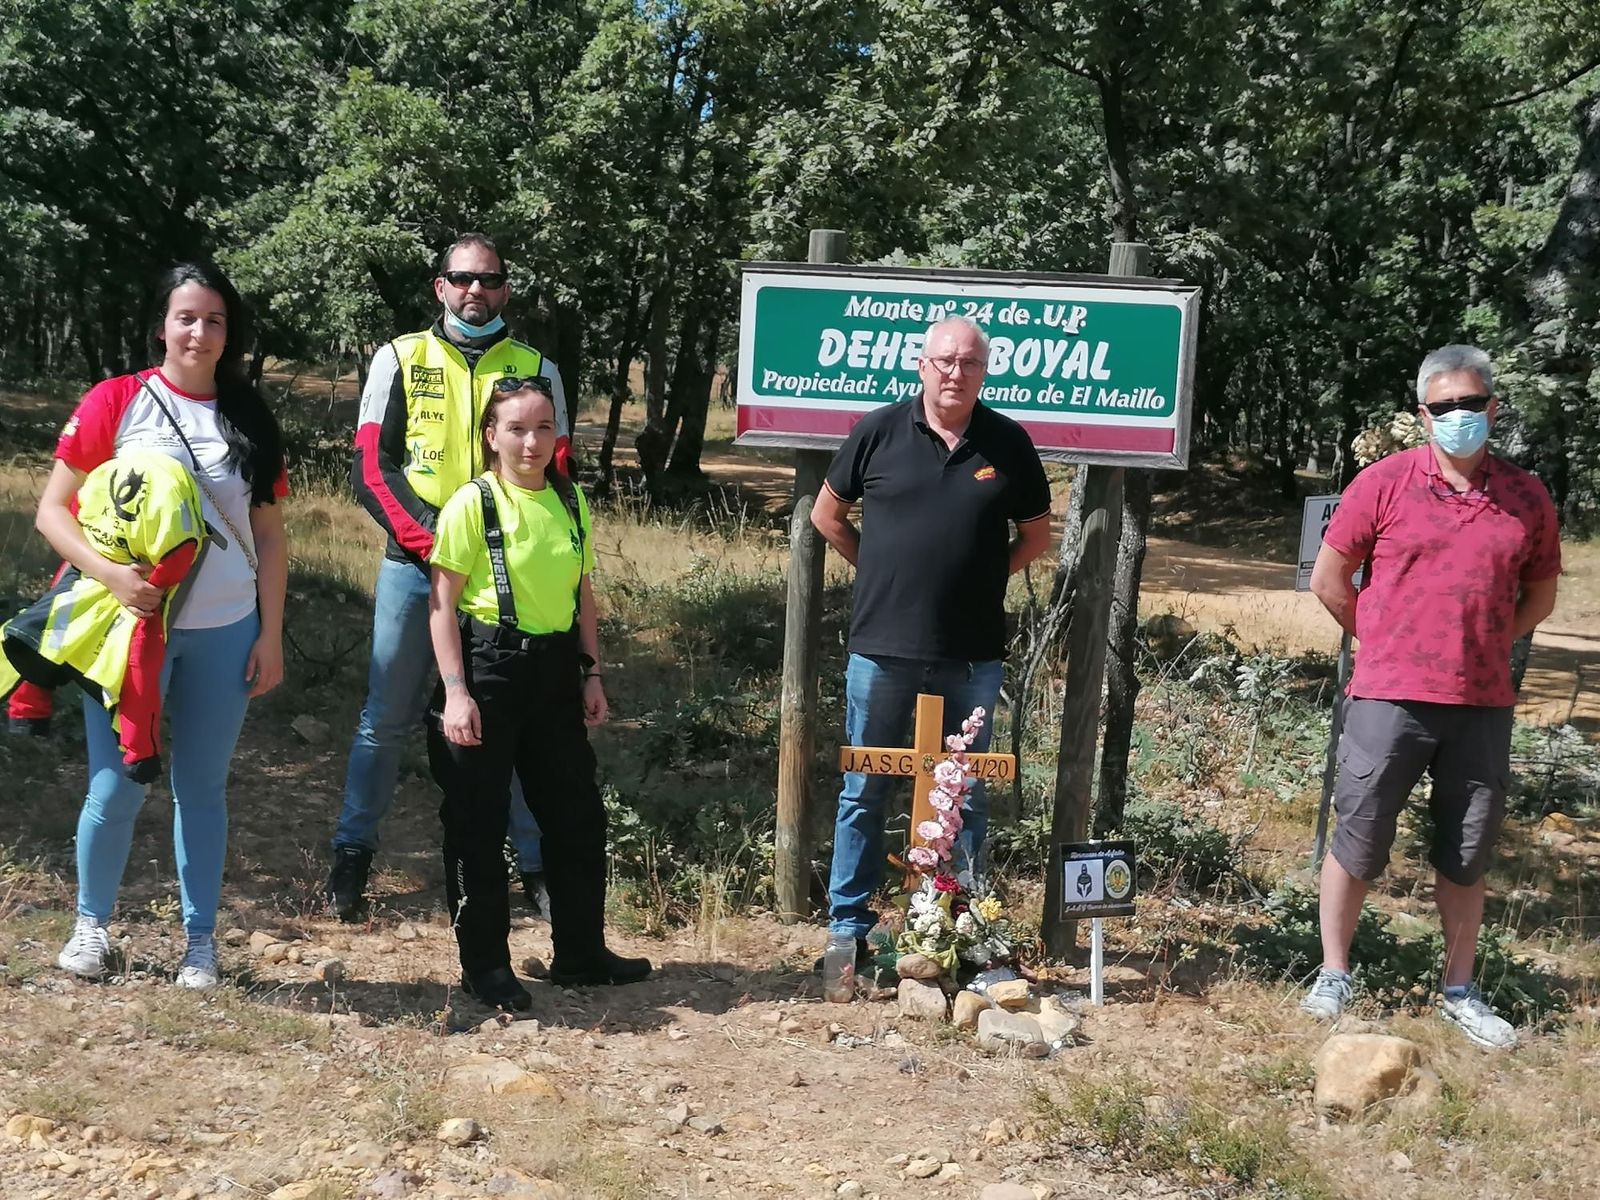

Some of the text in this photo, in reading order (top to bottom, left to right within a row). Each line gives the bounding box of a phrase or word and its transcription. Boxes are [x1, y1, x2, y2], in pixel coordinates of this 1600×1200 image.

[844, 296, 923, 322] Monte
[962, 302, 994, 325] 24
[998, 302, 1031, 325] de
[817, 328, 1111, 380] DEHE BOYAL
[761, 368, 877, 396] Propiedad:
[1037, 382, 1065, 405] de
[1070, 385, 1092, 406] El
[1095, 386, 1165, 410] Maillo
[845, 752, 918, 774] J.A.S.G.
